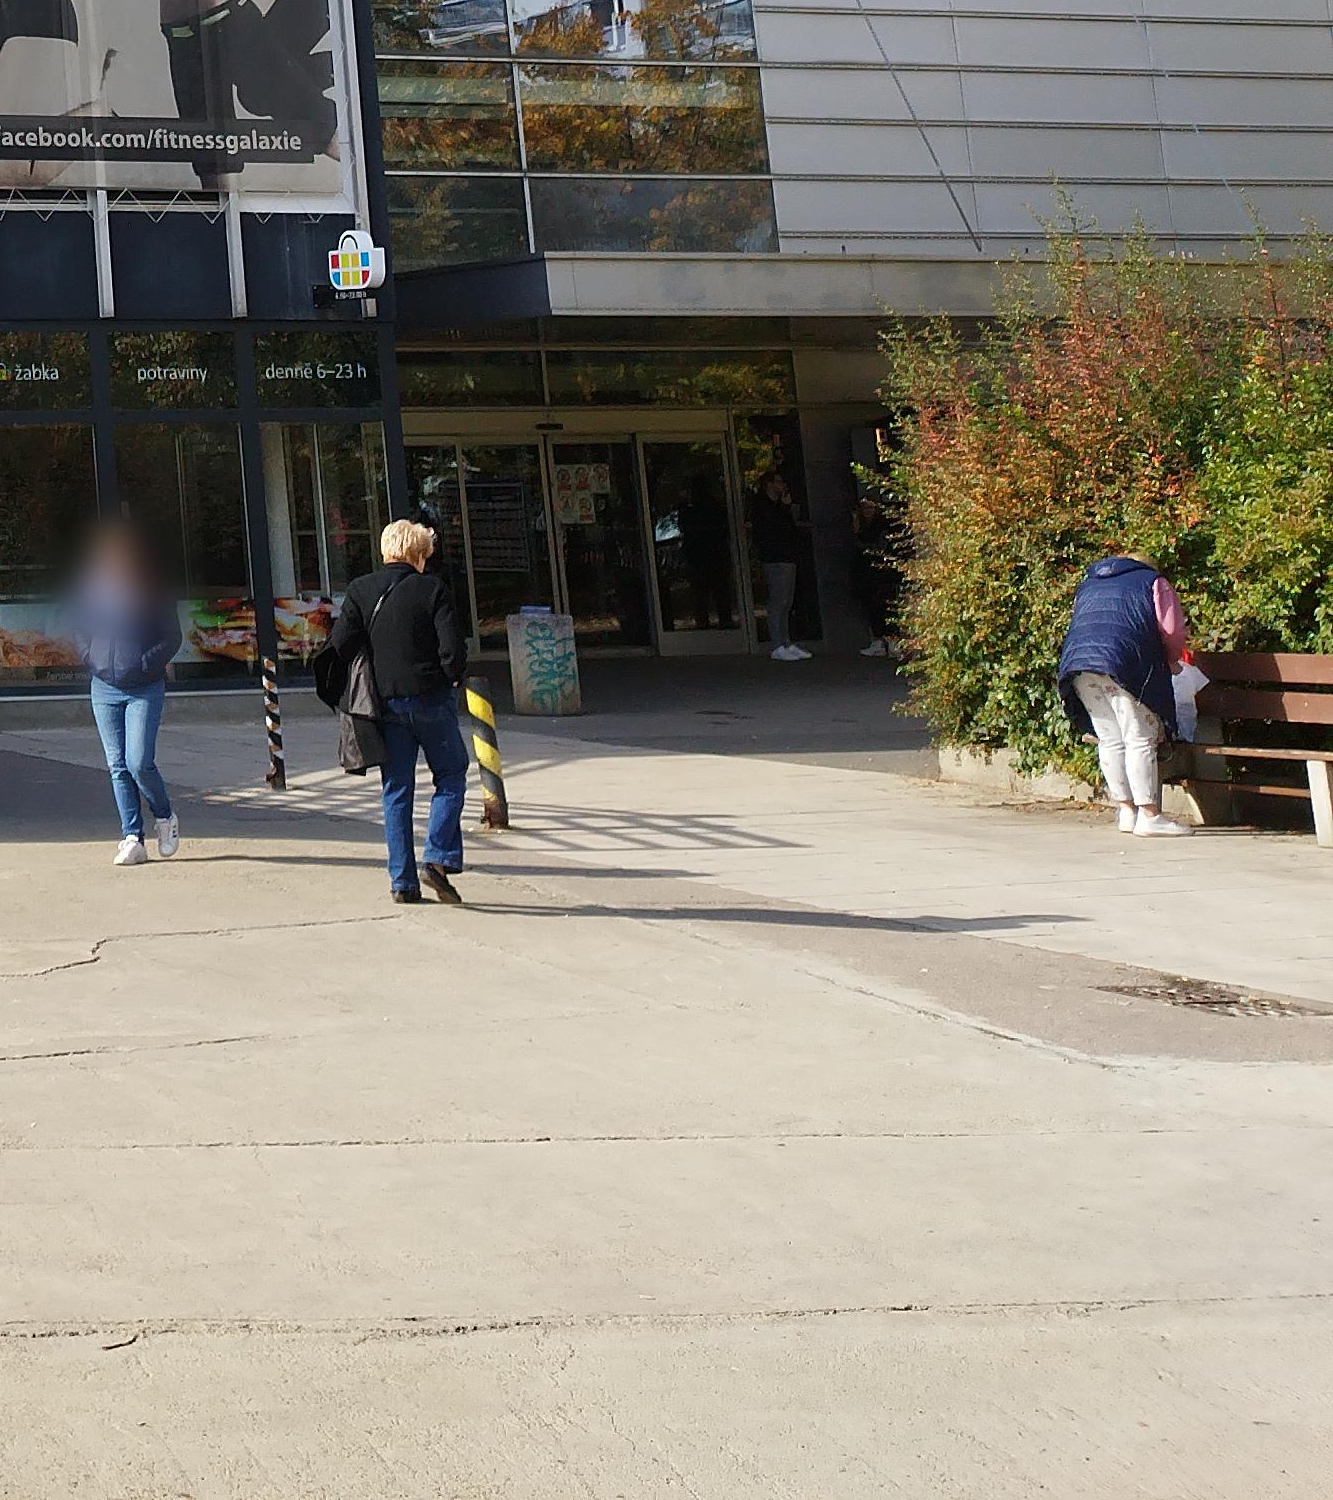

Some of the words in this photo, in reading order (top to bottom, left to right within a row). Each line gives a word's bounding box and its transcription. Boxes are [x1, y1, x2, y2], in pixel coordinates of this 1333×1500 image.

[15, 363, 60, 381] žabka
[137, 364, 208, 383] potraviny
[265, 363, 312, 380] denně
[358, 363, 367, 379] h
